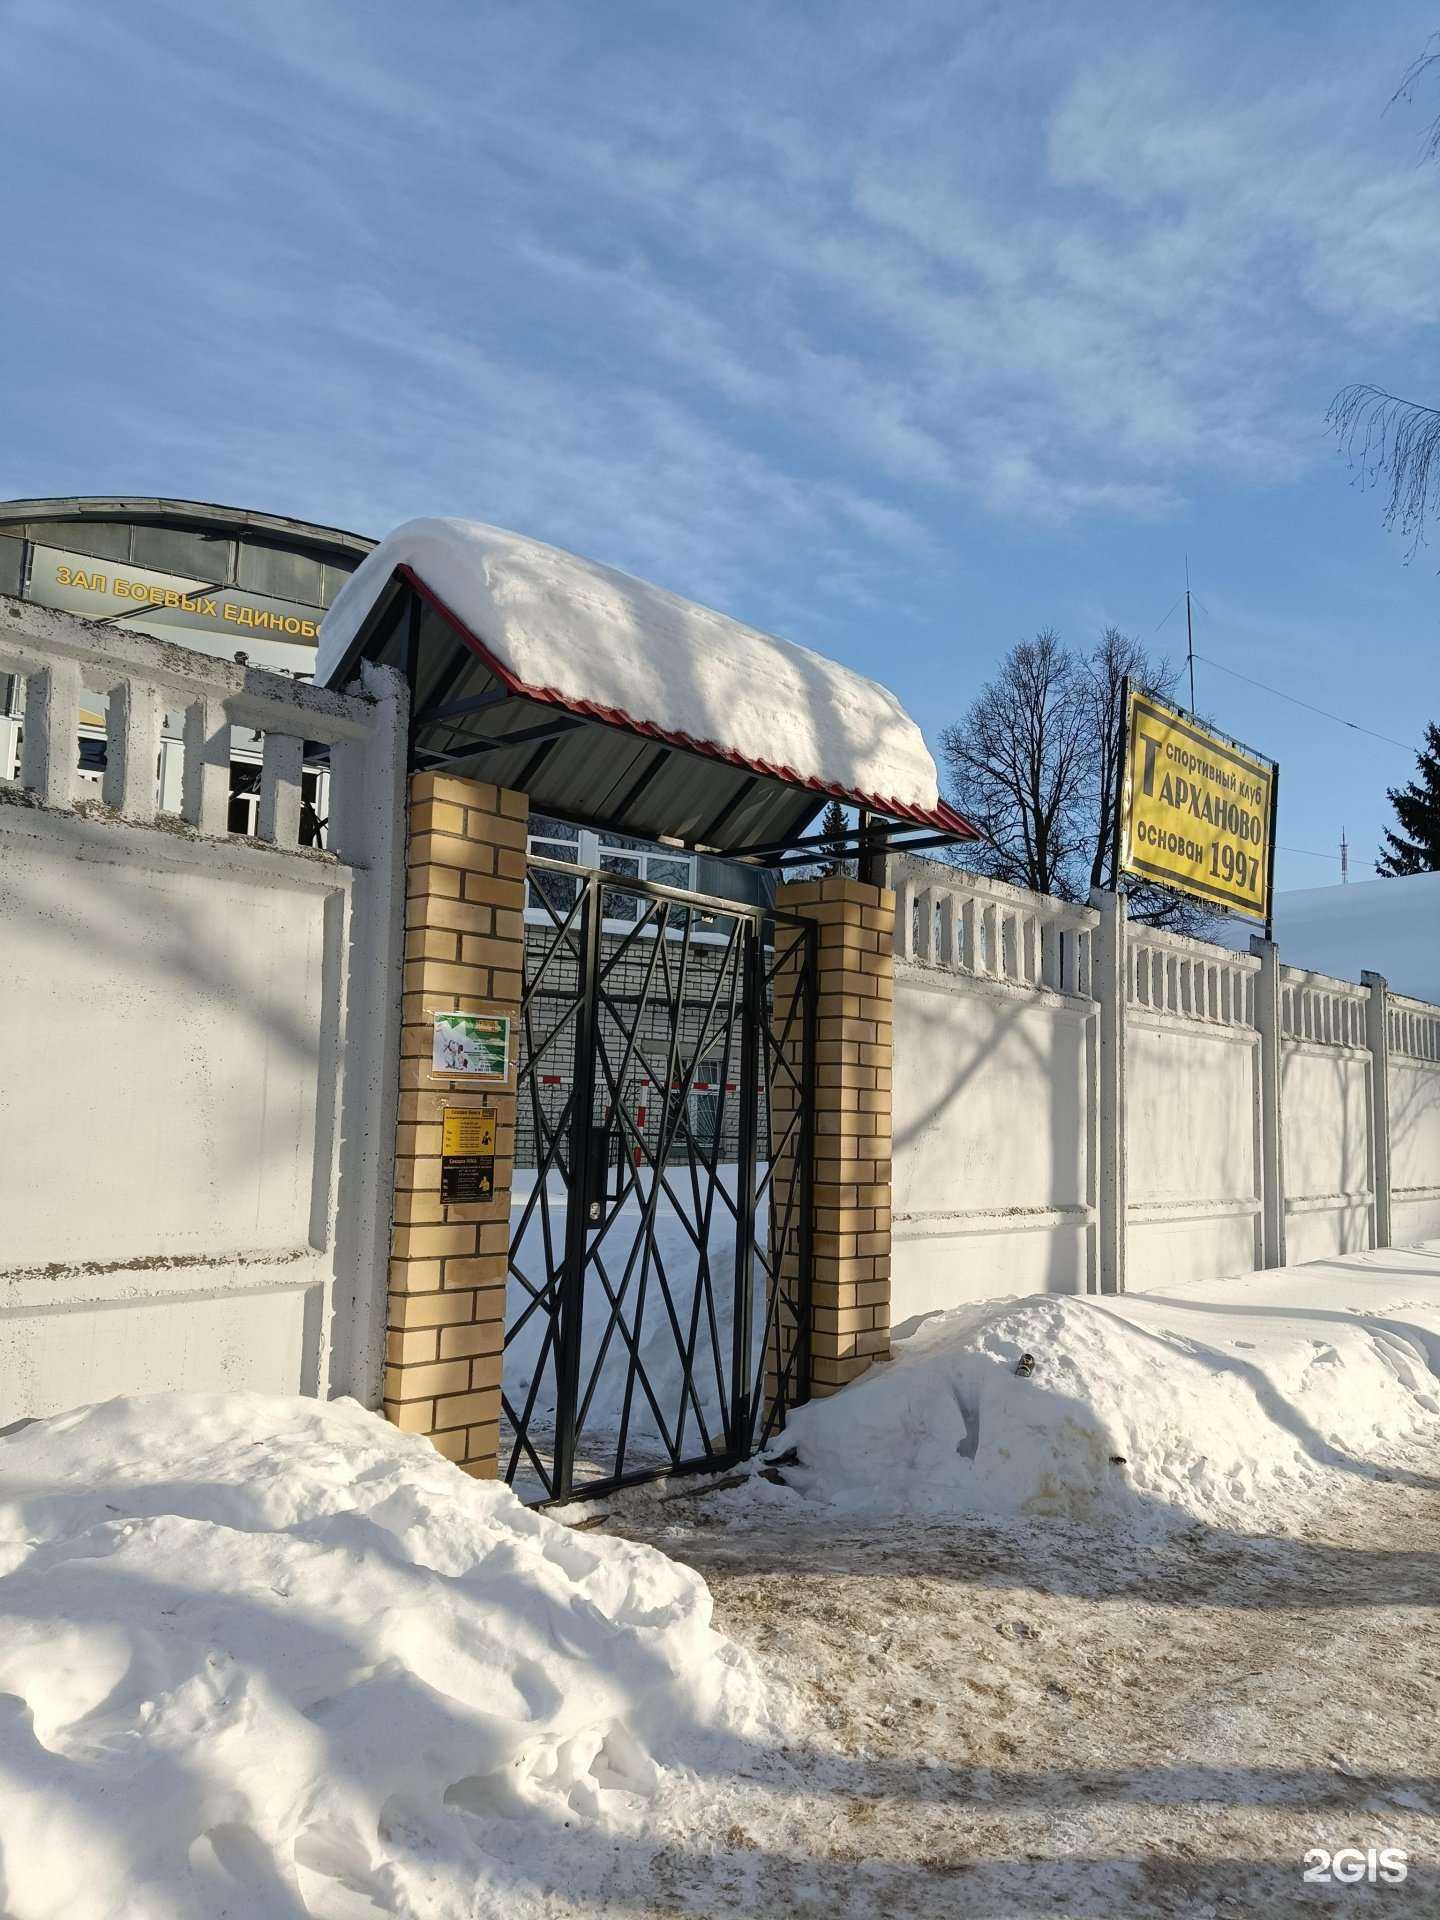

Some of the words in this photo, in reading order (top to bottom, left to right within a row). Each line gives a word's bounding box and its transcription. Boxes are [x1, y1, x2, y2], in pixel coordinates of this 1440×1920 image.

[56, 567, 106, 593] ЗАЛ
[114, 578, 217, 617] БОЕВЫХ
[224, 603, 320, 638] ЕДИНОБ
[1139, 732, 1262, 846] ТАРХАНОВО
[1209, 840, 1260, 892] 1997
